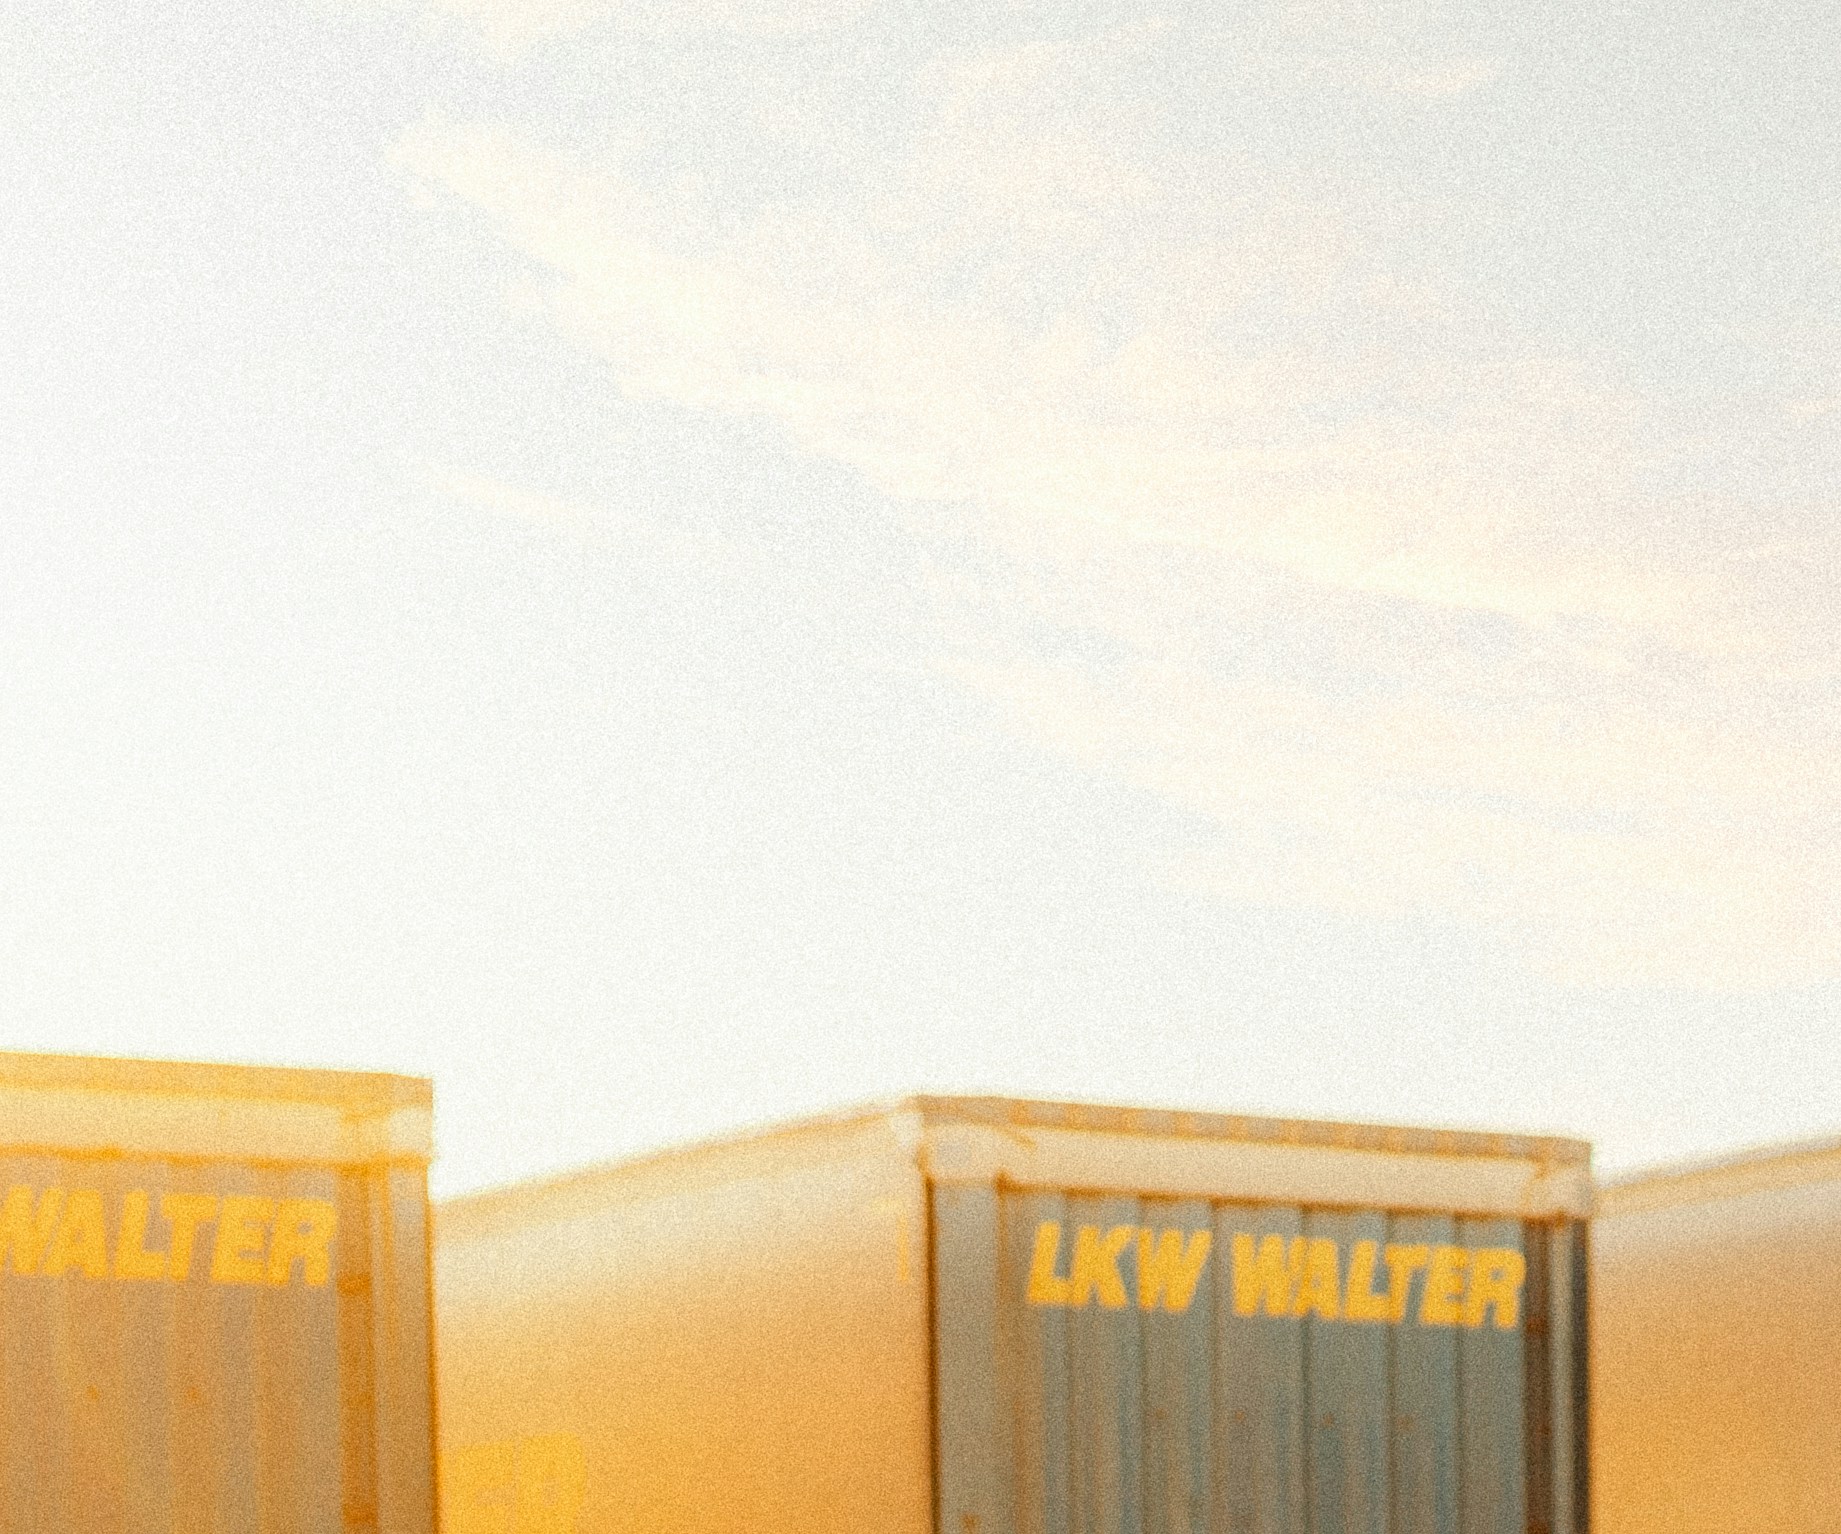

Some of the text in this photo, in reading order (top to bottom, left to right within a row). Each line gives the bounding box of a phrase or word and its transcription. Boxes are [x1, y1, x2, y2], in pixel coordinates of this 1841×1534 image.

[0, 1185, 338, 1288] WALTER
[1026, 1219, 1526, 1330] LKW WALTER
